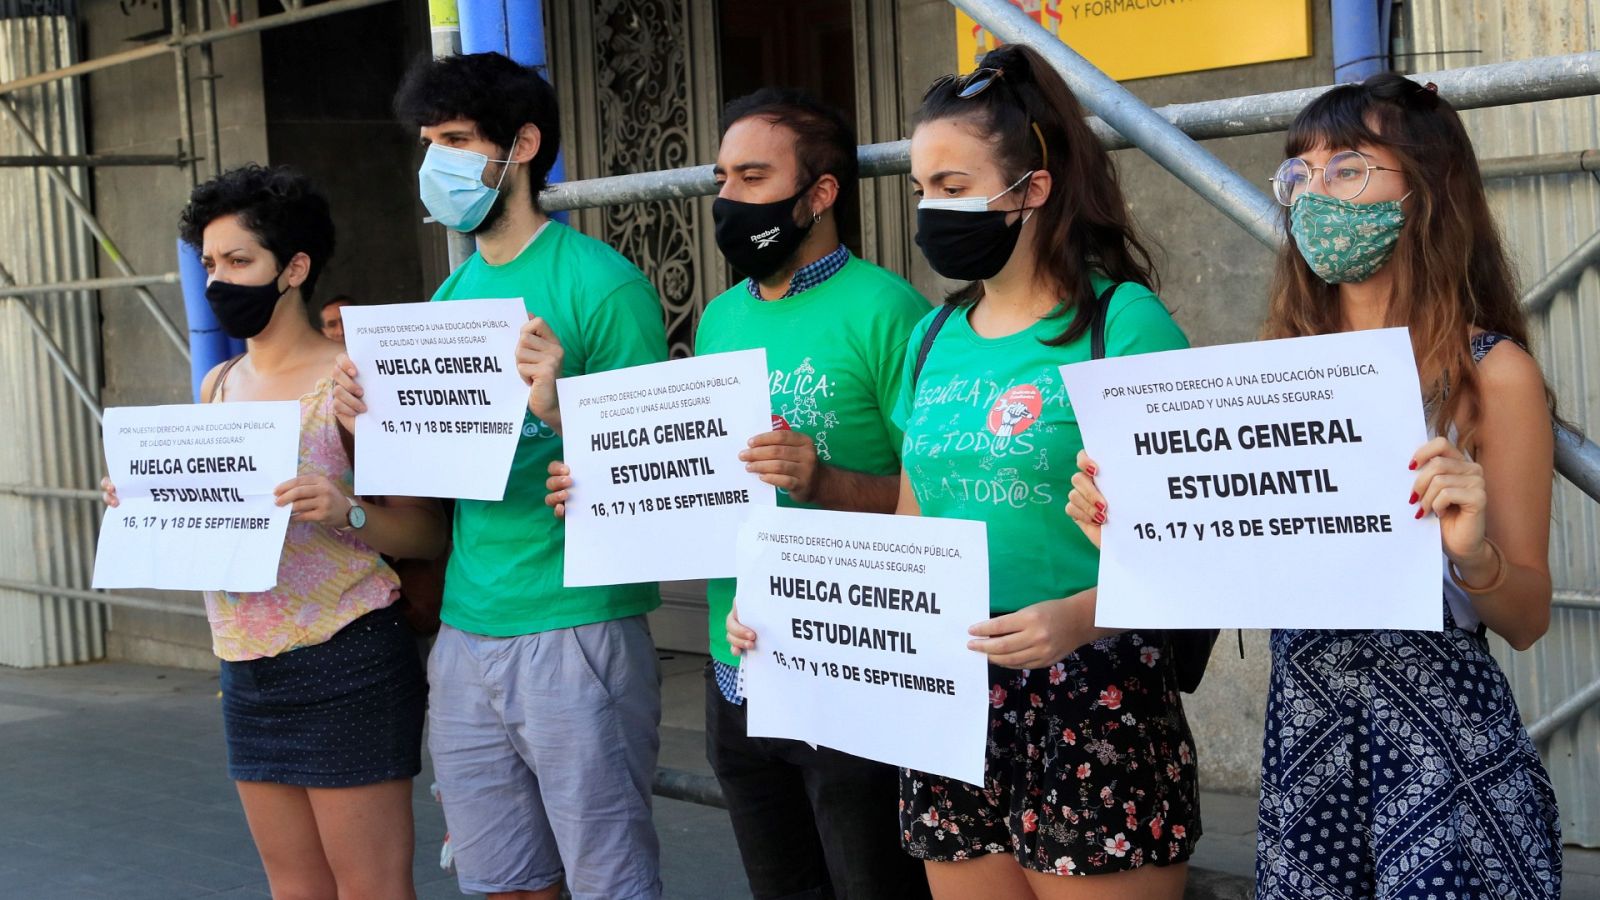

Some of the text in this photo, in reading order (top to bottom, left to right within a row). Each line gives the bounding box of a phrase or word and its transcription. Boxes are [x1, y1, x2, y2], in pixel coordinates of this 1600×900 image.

[1072, 5, 1080, 20] Y
[750, 226, 780, 242] Reebok
[375, 356, 502, 376] HUELGA GENERAL
[592, 394, 618, 405] NUESTRO
[619, 390, 647, 401] DERECHO
[653, 386, 668, 396] UNA
[668, 380, 706, 394] EDUCACIÓN
[1102, 364, 1379, 400] ¡POR NUESTRO DERECHO A UNA EDUCACIÓN PÚBLICA,
[397, 389, 491, 406] ESTUDIANTIL
[600, 410, 608, 419] DE
[609, 406, 635, 418] CALIDAD
[640, 403, 659, 414] UNAS
[659, 400, 680, 411] AULAS
[680, 396, 711, 408] SEGURAS!
[1146, 389, 1334, 414] DE CALIDAD Y UNAS AULAS SEGURAS!
[382, 420, 398, 435] 16,
[400, 421, 412, 433] 17
[424, 421, 438, 433] 18
[439, 421, 453, 433] DE
[455, 421, 514, 435] SEPTIEMBRE
[591, 418, 728, 452] HUELGA GENERAL
[1134, 418, 1363, 456] HUELGA GENERAL
[130, 456, 257, 475] HUELGA GENERAL
[611, 456, 715, 485] ESTUDIANTIL
[150, 488, 245, 502] ESTUDIANTIL
[1167, 469, 1338, 500] ESTUDIANTIL
[591, 503, 610, 518] 16,
[611, 501, 625, 515] 17
[638, 498, 654, 513] 18
[656, 497, 672, 511] DE
[674, 489, 750, 509] SEPTIEMBRE
[123, 516, 138, 530] 16,
[143, 517, 157, 527] 17
[171, 517, 185, 529] 18
[187, 517, 202, 529] DE
[204, 517, 270, 530] SEPTIEMBRE
[1134, 523, 1162, 542] 16,
[1166, 522, 1187, 539] 17
[1210, 520, 1235, 538] 18
[1238, 519, 1264, 537] DE
[1269, 514, 1393, 536] SEPTIEMBRE
[769, 534, 805, 545] NUESTRO
[805, 536, 844, 549] DERECHO
[845, 540, 851, 549] A
[852, 540, 871, 551] UNA
[872, 542, 922, 555] EDUCACIÓN
[924, 545, 962, 559] PÚBLICA,
[781, 551, 926, 574] DE CALIDAD Y UNAS AULAS SEGURAS!
[770, 575, 941, 615] HUELGA GENERAL
[792, 618, 917, 655] ESTUDIANTIL
[773, 650, 791, 670] 16,
[791, 656, 806, 671] 17
[821, 662, 839, 678] 18
[842, 665, 861, 682] DE
[864, 668, 956, 696] SEPTIEMBRE
